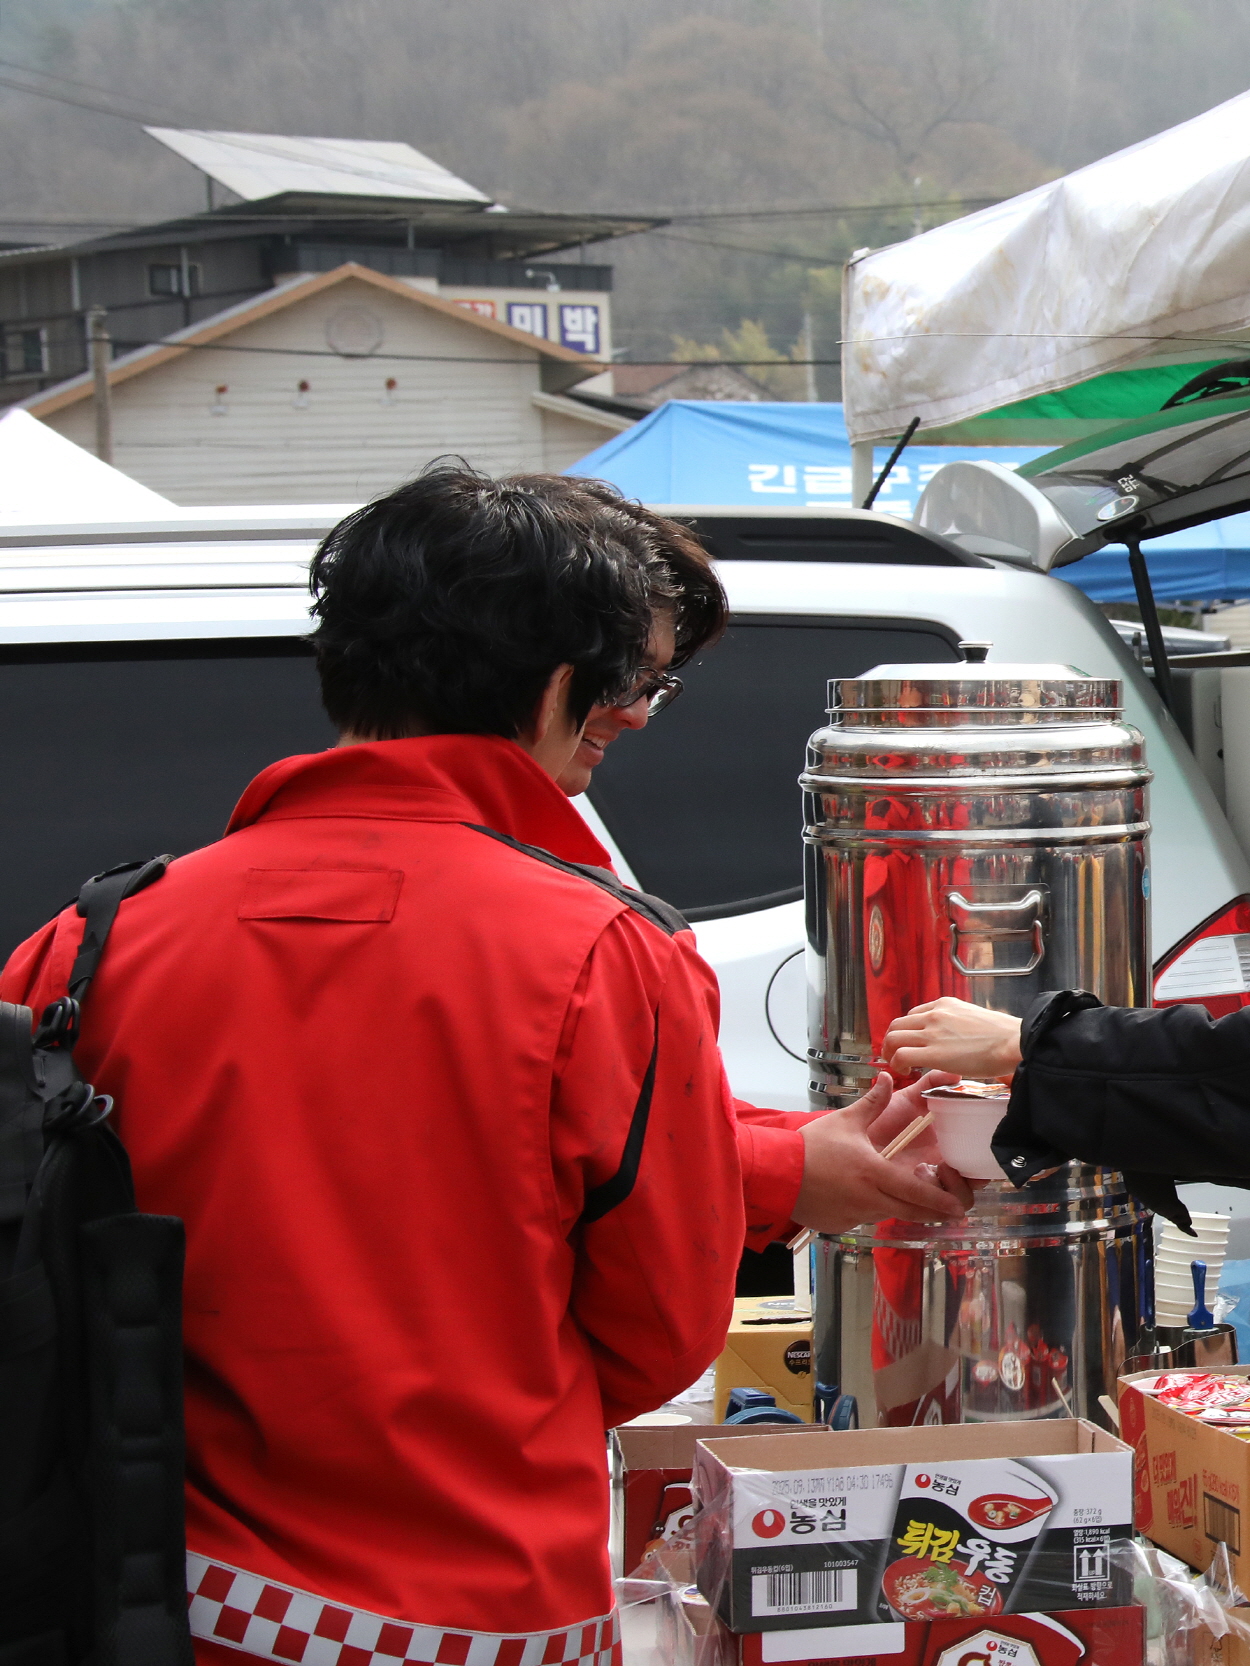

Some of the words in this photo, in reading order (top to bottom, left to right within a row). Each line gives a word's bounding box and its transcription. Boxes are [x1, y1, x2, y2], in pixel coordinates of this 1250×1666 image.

[931, 1479, 960, 1496] 농심
[789, 1508, 847, 1535] 농심
[824, 1559, 859, 1568] 101003547
[977, 1584, 997, 1607] 컵
